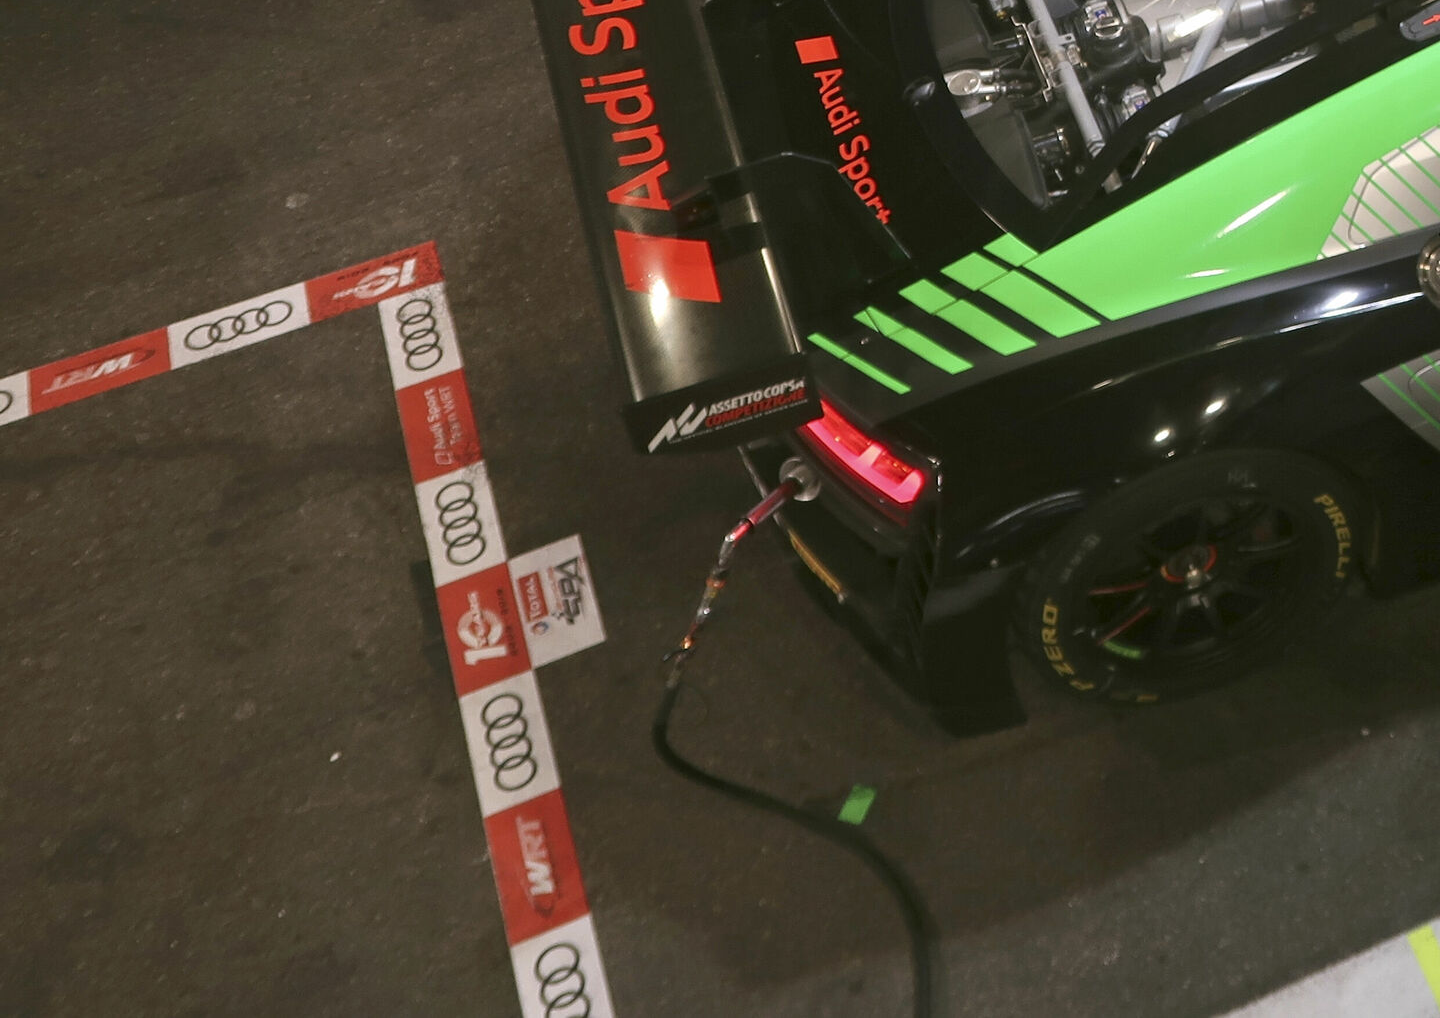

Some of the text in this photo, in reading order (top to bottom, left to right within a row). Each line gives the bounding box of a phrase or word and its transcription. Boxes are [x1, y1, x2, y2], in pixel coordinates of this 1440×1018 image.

[581, 68, 672, 212] Audi
[813, 66, 892, 225] Audi Sport
[424, 387, 446, 450] Audi Sport
[708, 390, 763, 416] ASSETTO
[525, 576, 542, 622] TOTAL
[1042, 600, 1075, 676] ZERO
[516, 815, 556, 896] WRT
